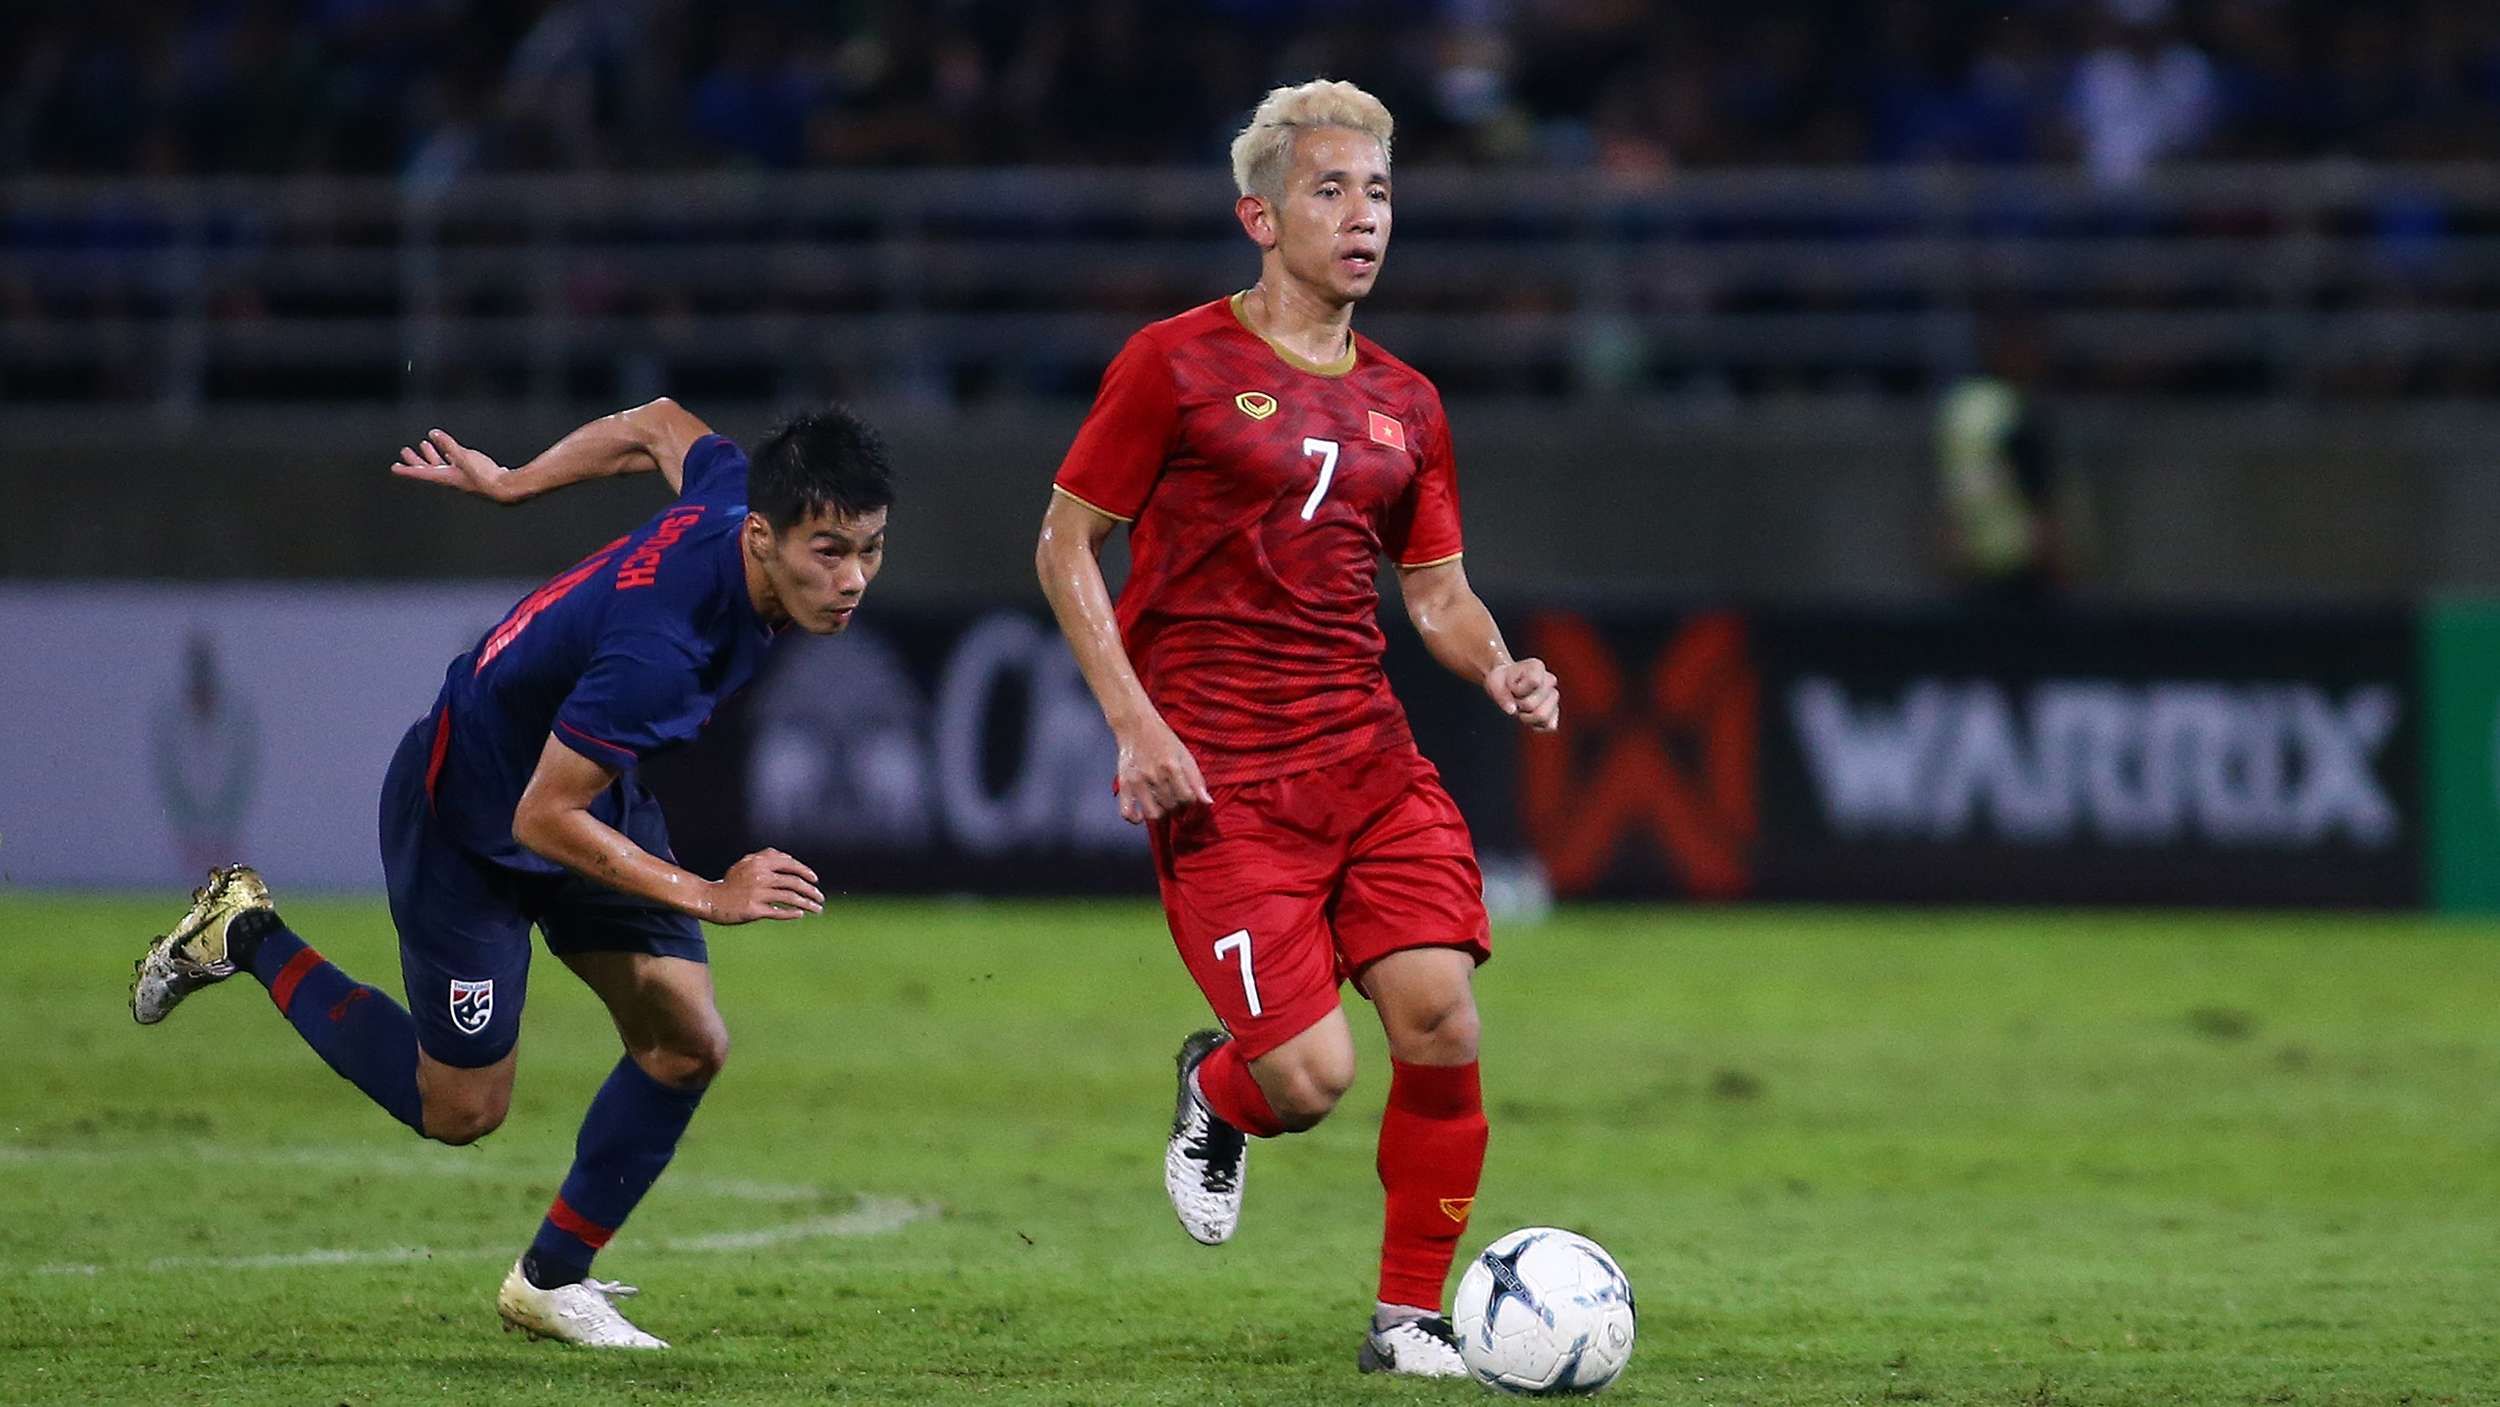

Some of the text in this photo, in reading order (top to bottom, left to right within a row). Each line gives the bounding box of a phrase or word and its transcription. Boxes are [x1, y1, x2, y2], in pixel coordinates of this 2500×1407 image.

[1301, 437, 1339, 520] 7
[1789, 674, 2398, 846] WARRIX
[1214, 928, 1263, 1018] 7
